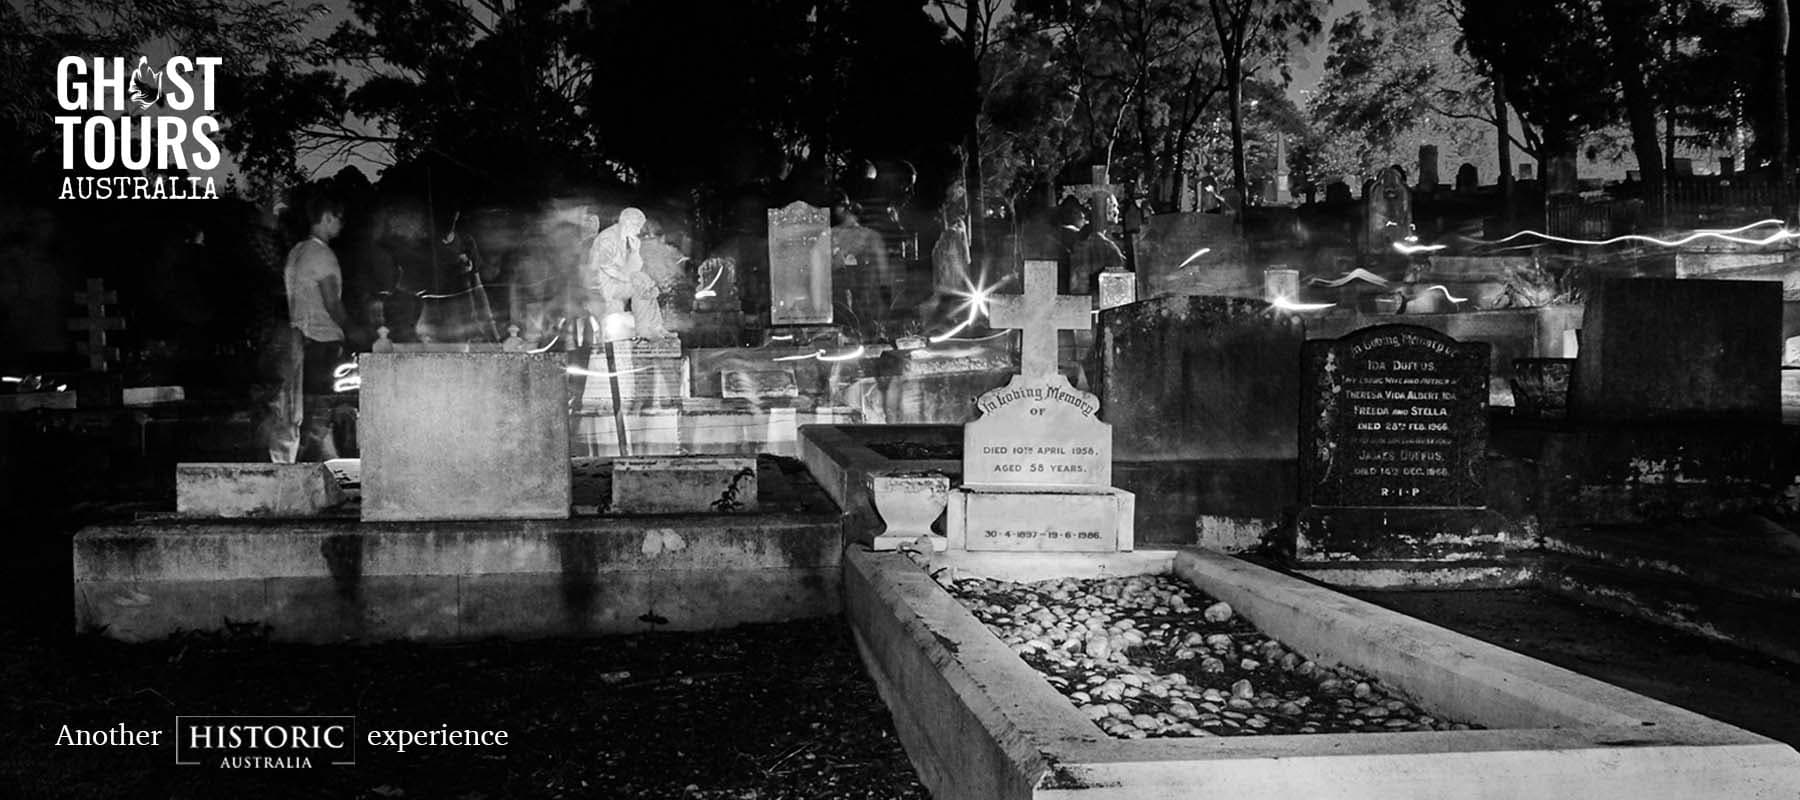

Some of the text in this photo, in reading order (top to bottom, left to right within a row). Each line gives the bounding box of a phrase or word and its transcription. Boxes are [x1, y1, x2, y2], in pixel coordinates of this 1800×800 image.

[1367, 360, 1386, 371] IDA
[983, 384, 1094, 417] In Loving Memory
[1411, 406, 1448, 416] STELLA
[1357, 422, 1381, 431] DIED
[983, 446, 1008, 455] DIED
[1037, 446, 1066, 455] APRIL
[993, 463, 1088, 473] AGED 58 YEARS.
[1353, 467, 1378, 476] DIED
